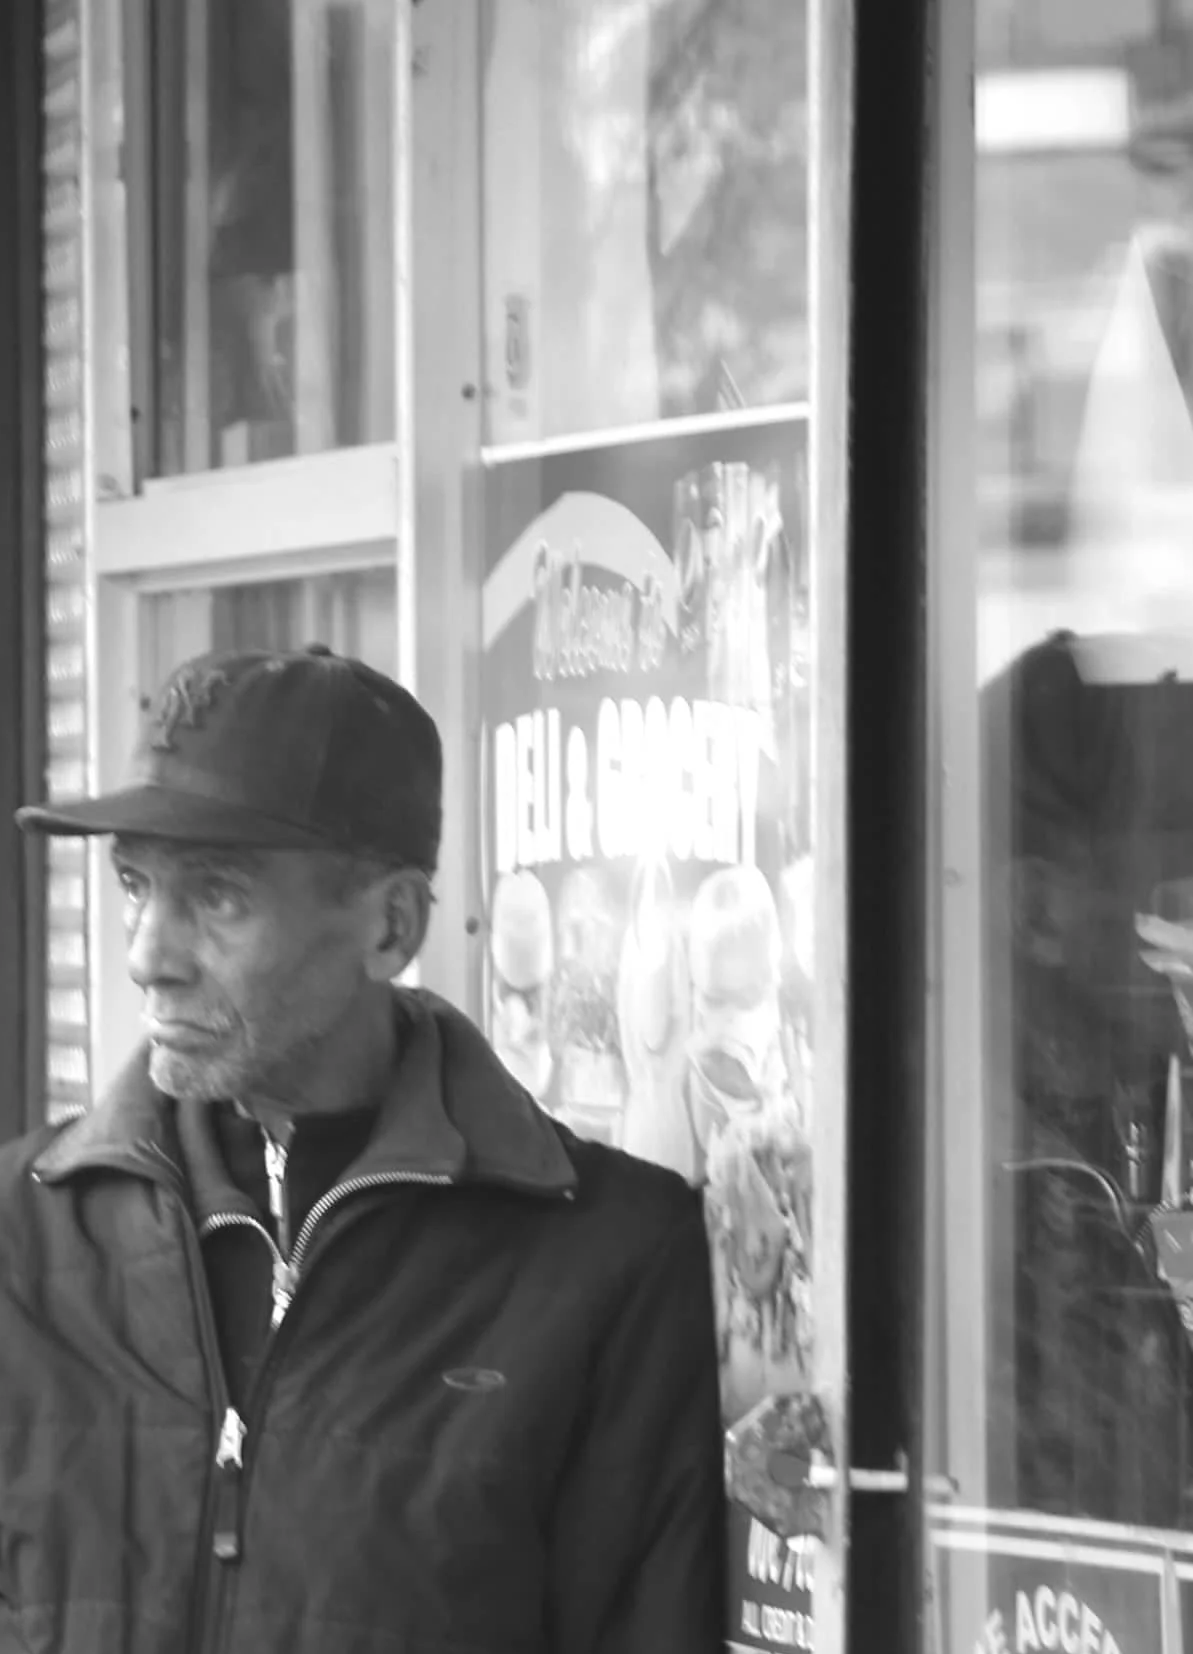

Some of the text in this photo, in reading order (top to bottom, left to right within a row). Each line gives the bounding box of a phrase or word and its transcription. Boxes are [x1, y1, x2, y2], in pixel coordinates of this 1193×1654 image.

[494, 694, 761, 874] DELI & GROCERY
